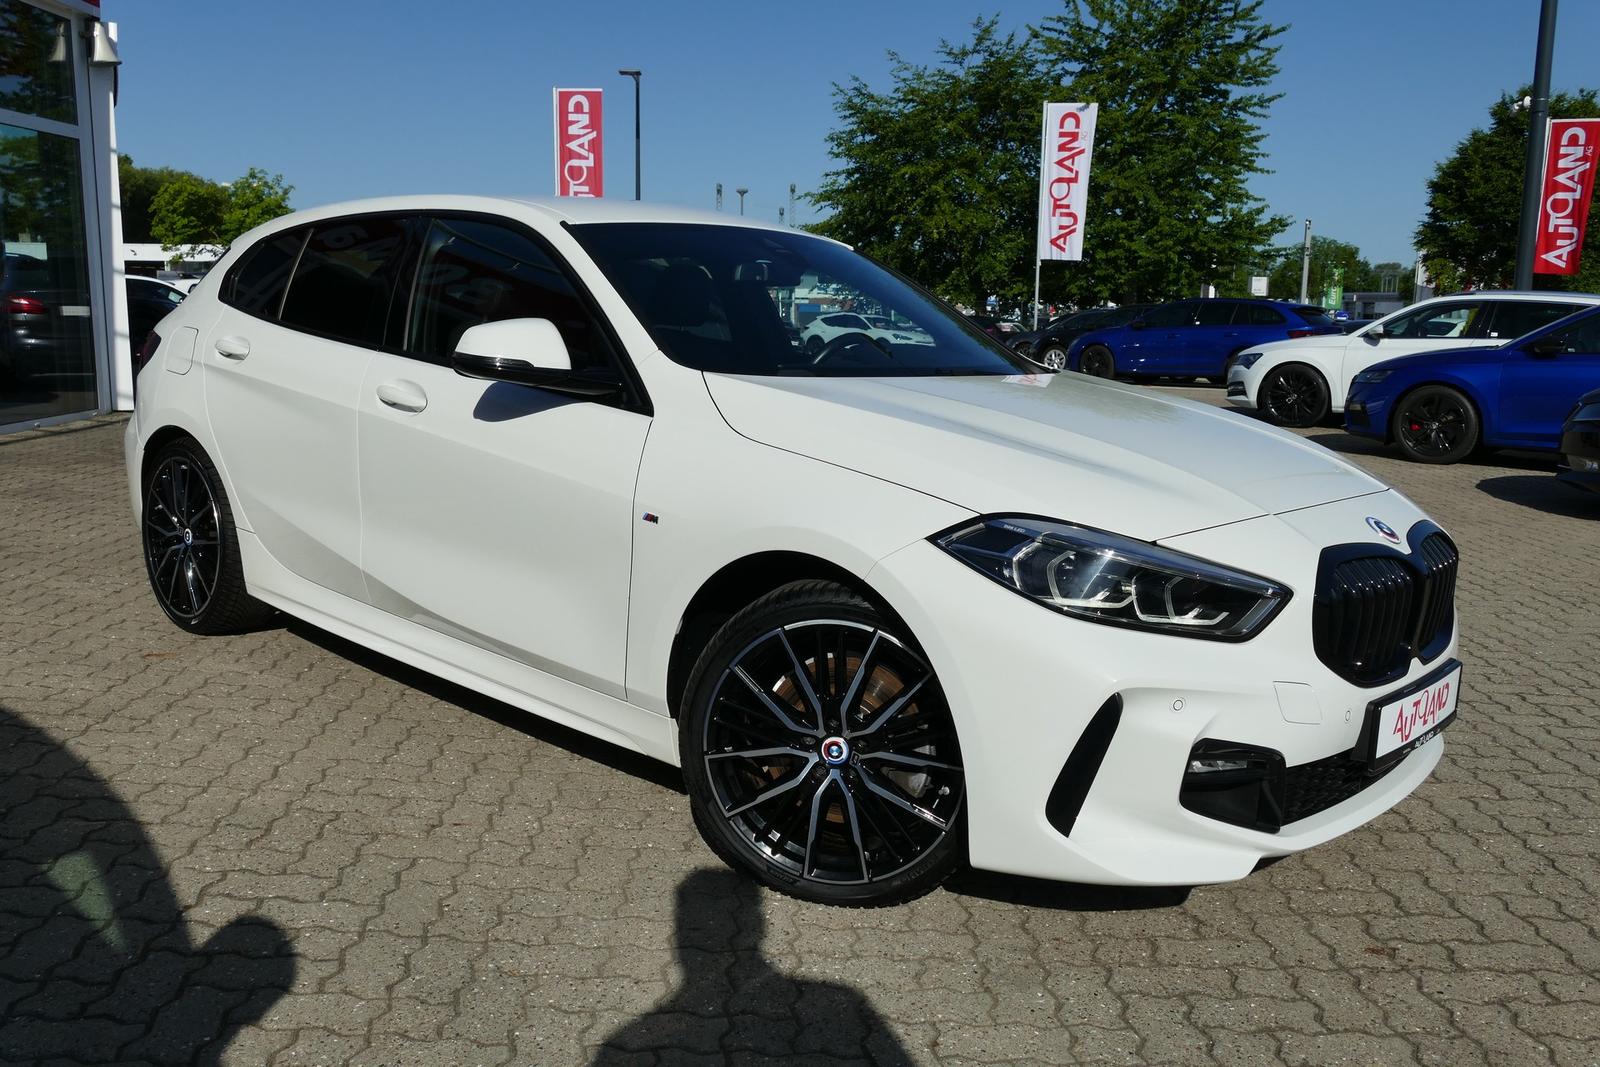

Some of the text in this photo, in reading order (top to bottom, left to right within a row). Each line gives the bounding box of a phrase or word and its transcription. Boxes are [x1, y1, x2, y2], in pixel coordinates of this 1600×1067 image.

[564, 94, 597, 198] TOLAND
[1049, 111, 1086, 254] AUTOLAND
[1540, 126, 1591, 269] AUTOLAND
[1392, 682, 1450, 743] AUTOLAND
